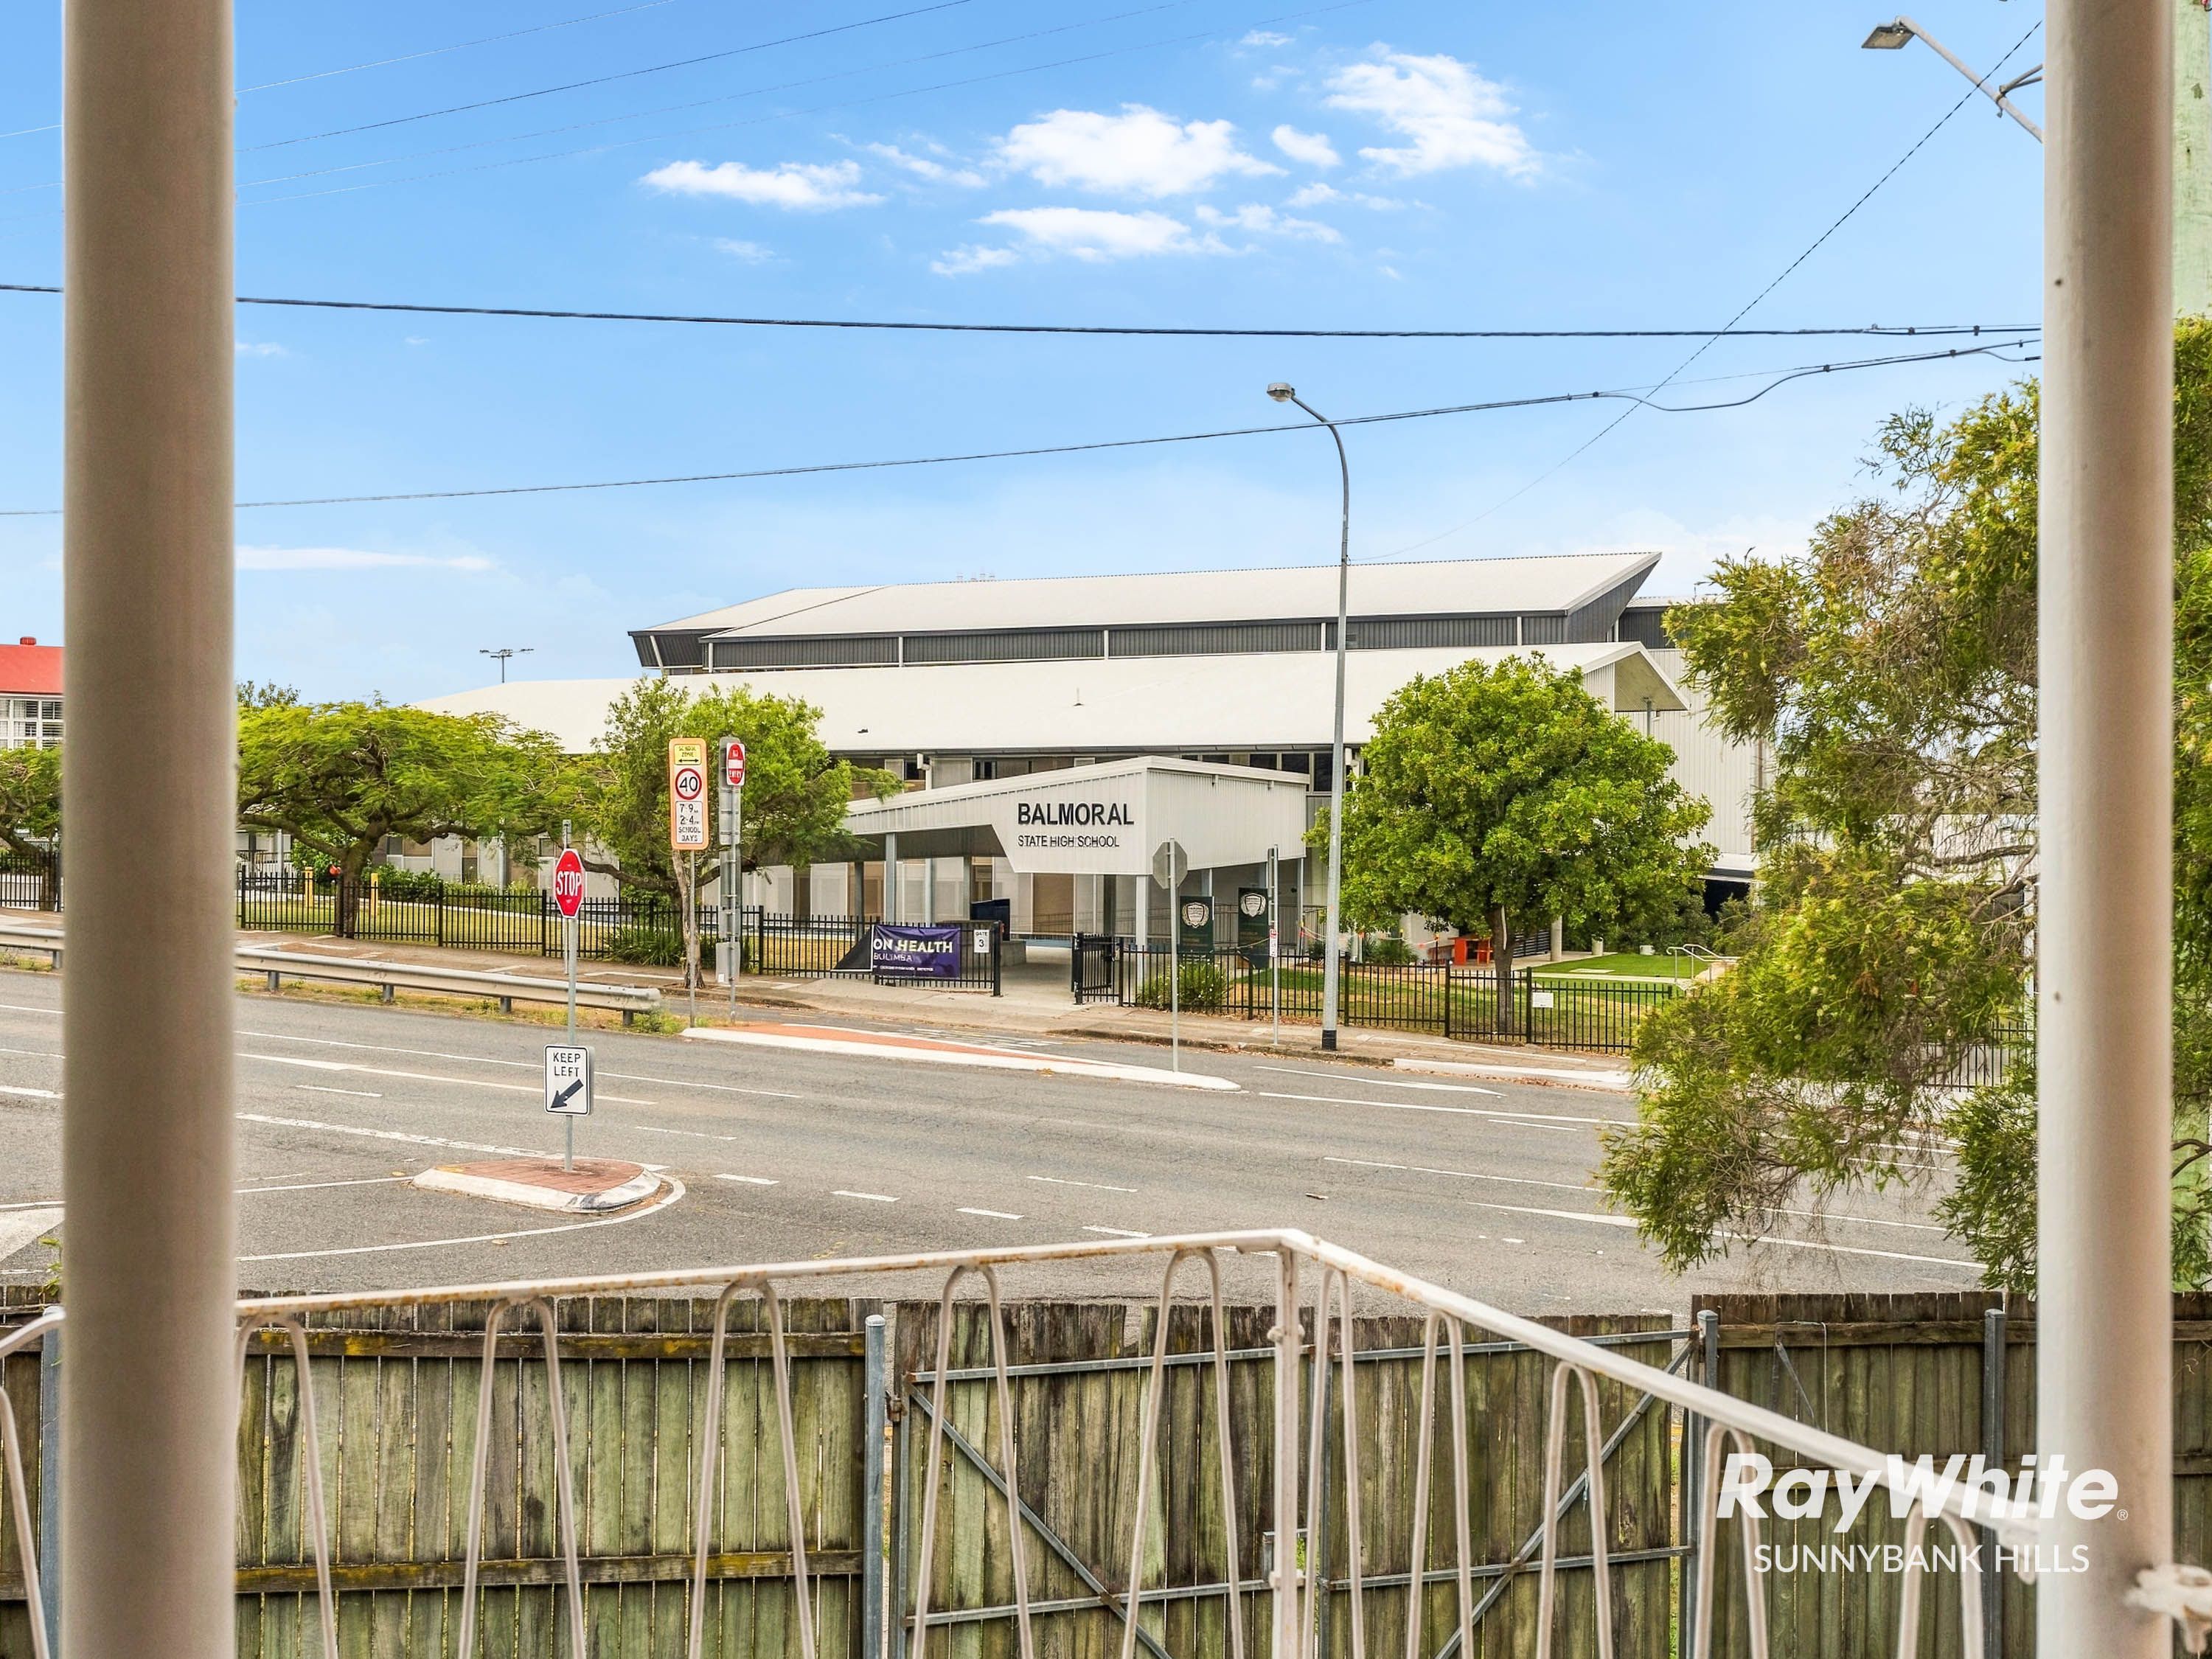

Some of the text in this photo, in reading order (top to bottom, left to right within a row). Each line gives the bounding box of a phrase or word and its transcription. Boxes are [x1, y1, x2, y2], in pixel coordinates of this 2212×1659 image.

[679, 776, 698, 792] 40
[1018, 803, 1135, 825] BALMORAL
[1018, 835, 1120, 847] STATE HIGH SCHOOL
[556, 871, 582, 897] STOP
[897, 939, 953, 953] HEALTH
[978, 939, 985, 948] 3
[553, 1052, 581, 1063] KEEP
[554, 1066, 580, 1077] LEFT
